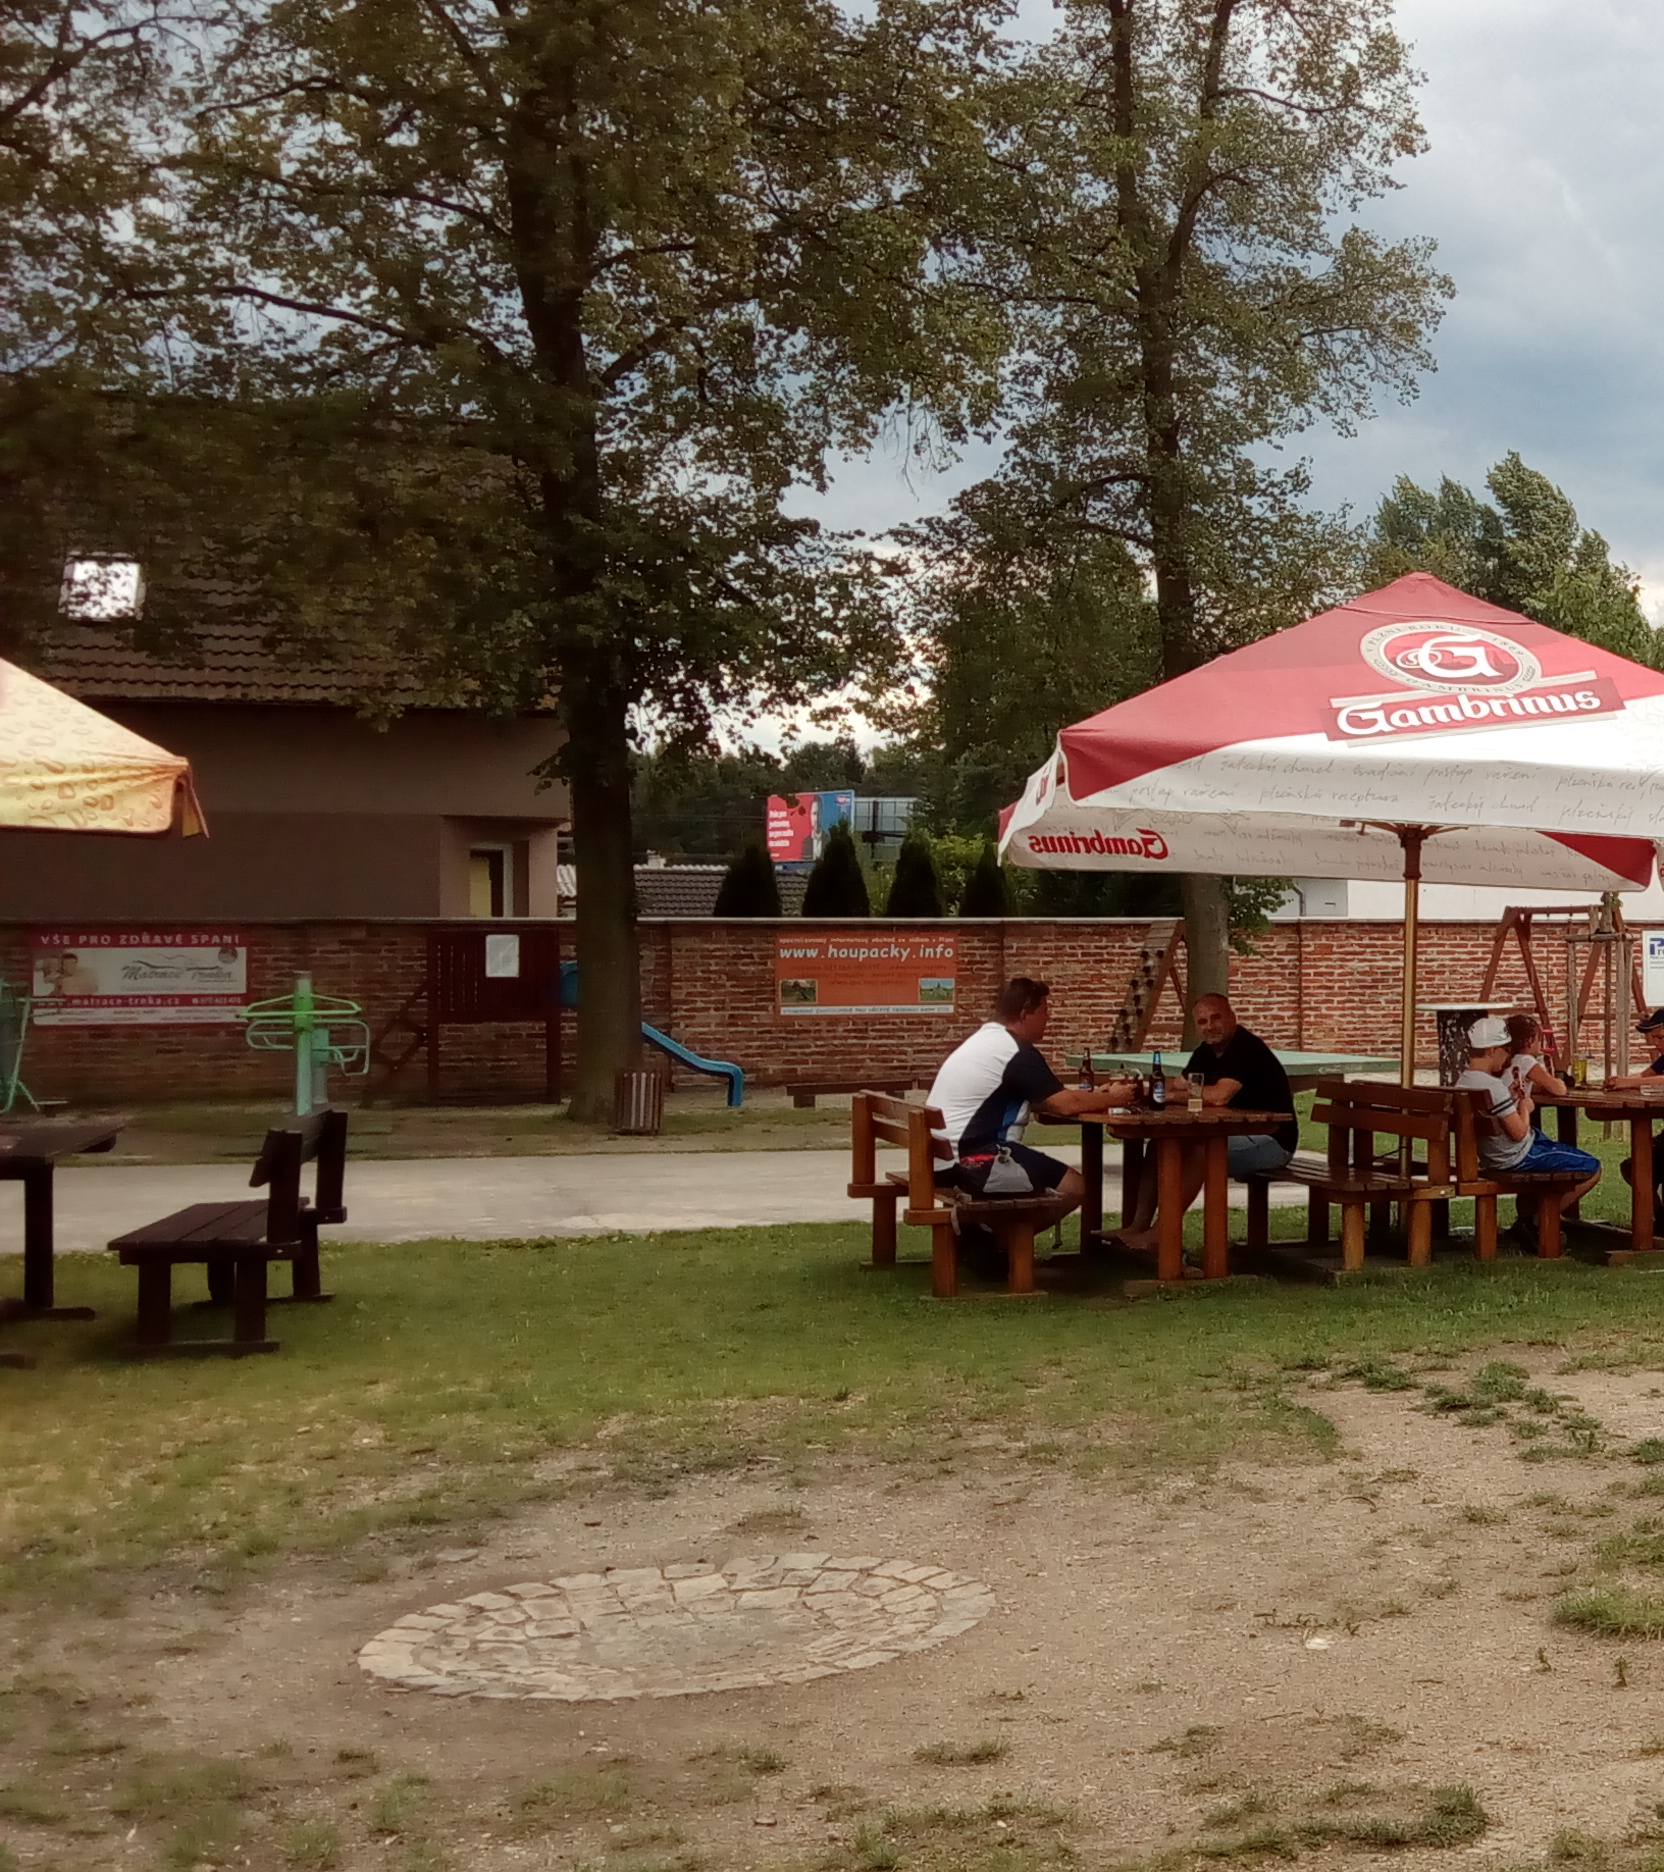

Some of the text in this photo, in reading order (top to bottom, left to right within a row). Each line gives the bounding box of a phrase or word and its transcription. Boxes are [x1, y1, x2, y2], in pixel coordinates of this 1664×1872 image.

[1337, 689, 1602, 737] Gambrinus
[40, 934, 71, 946] VŠE
[79, 935, 110, 946] PRO
